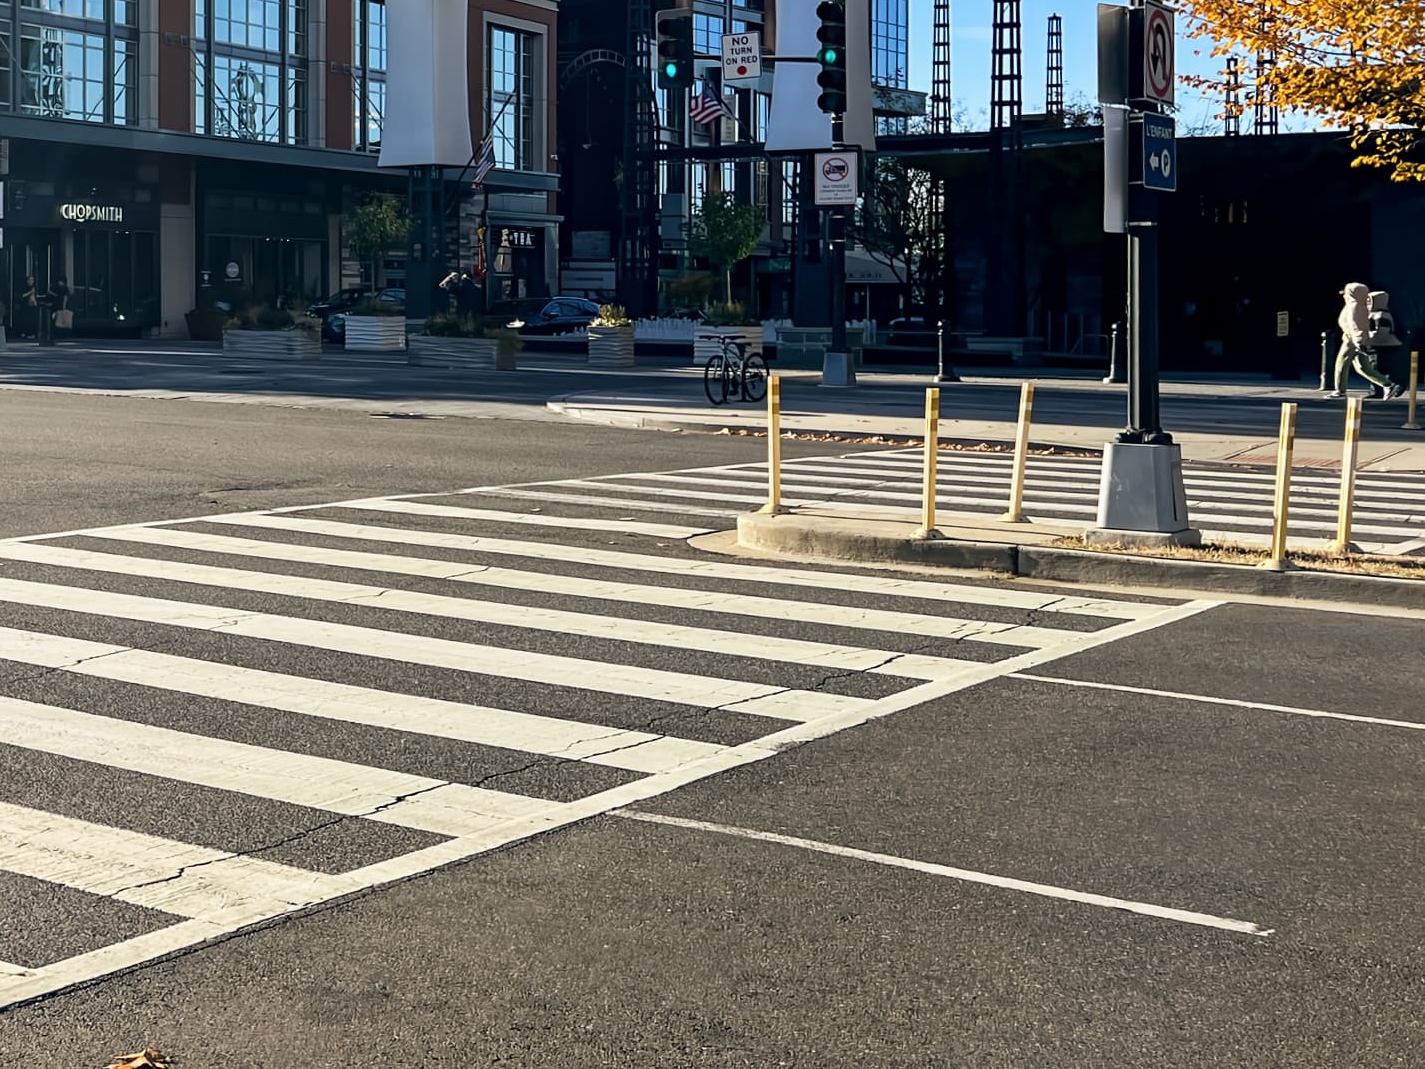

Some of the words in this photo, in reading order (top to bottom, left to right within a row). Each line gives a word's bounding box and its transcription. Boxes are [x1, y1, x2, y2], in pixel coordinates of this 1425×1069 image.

[732, 36, 749, 46] NO
[730, 46, 753, 55] TURN
[726, 57, 737, 65] ON
[741, 55, 758, 63] RED
[61, 204, 123, 222] CHOPSMITH
